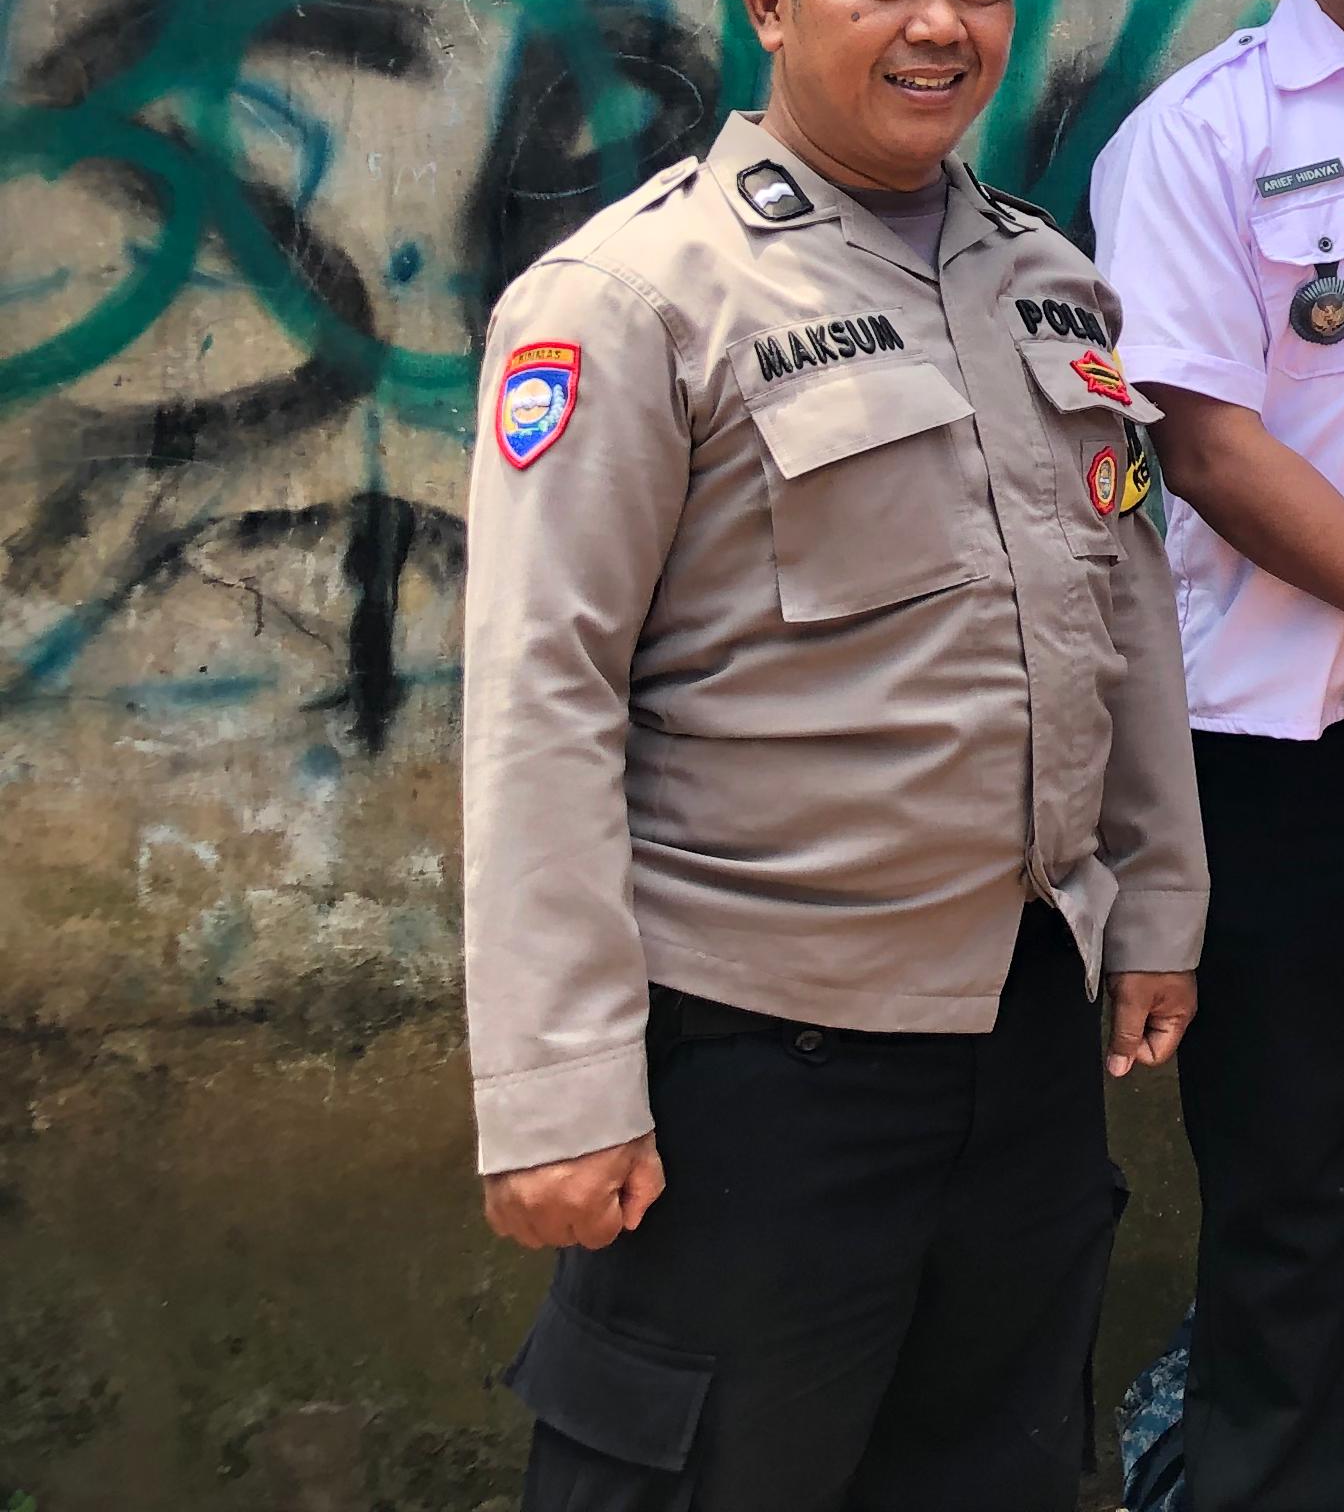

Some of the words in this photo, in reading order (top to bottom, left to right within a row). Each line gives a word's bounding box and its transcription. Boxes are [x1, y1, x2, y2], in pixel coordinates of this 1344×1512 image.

[1264, 175, 1294, 192] ARIEF
[1296, 163, 1339, 183] HIDAYAT
[754, 314, 904, 382] MAKSUM
